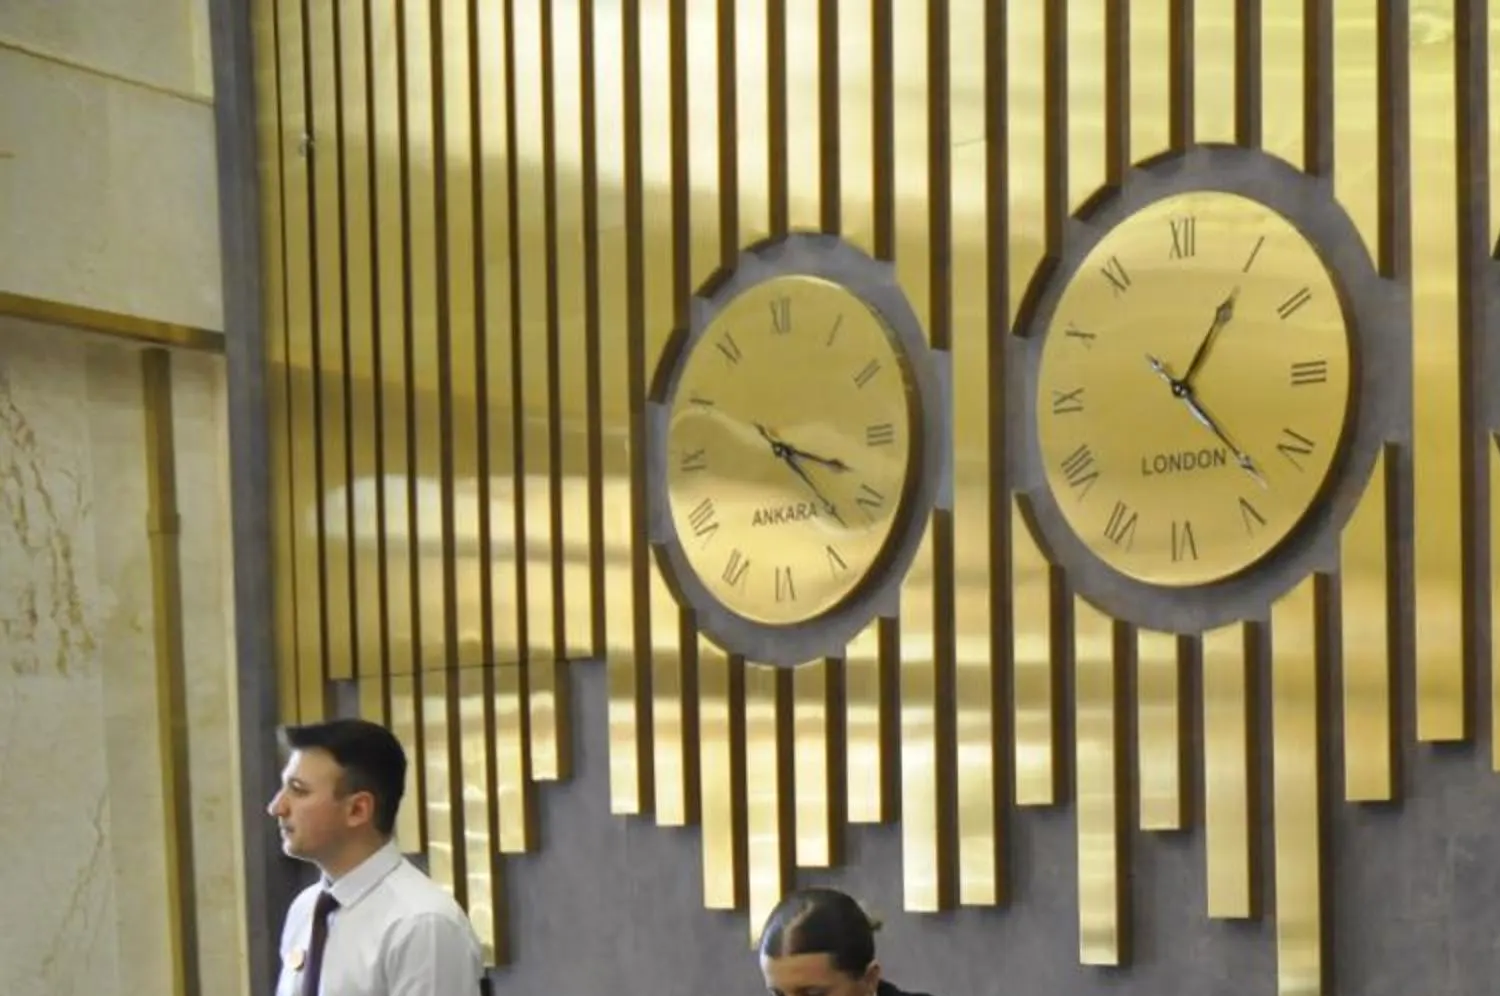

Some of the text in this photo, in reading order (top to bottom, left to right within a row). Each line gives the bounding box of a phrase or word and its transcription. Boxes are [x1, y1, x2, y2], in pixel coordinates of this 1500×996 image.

[1170, 218, 1195, 259] XII
[1101, 256, 1131, 297] XI
[1277, 287, 1312, 319] II
[1065, 323, 1096, 348] X
[1291, 361, 1327, 386] III
[1053, 387, 1083, 414] IX
[1141, 448, 1226, 476] LONDON
[1277, 428, 1315, 472] IV
[1061, 444, 1098, 502] VIII
[752, 503, 818, 527] ANKARA
[1104, 501, 1138, 553] VII
[1239, 497, 1266, 538] V
[1172, 520, 1198, 562] VI
